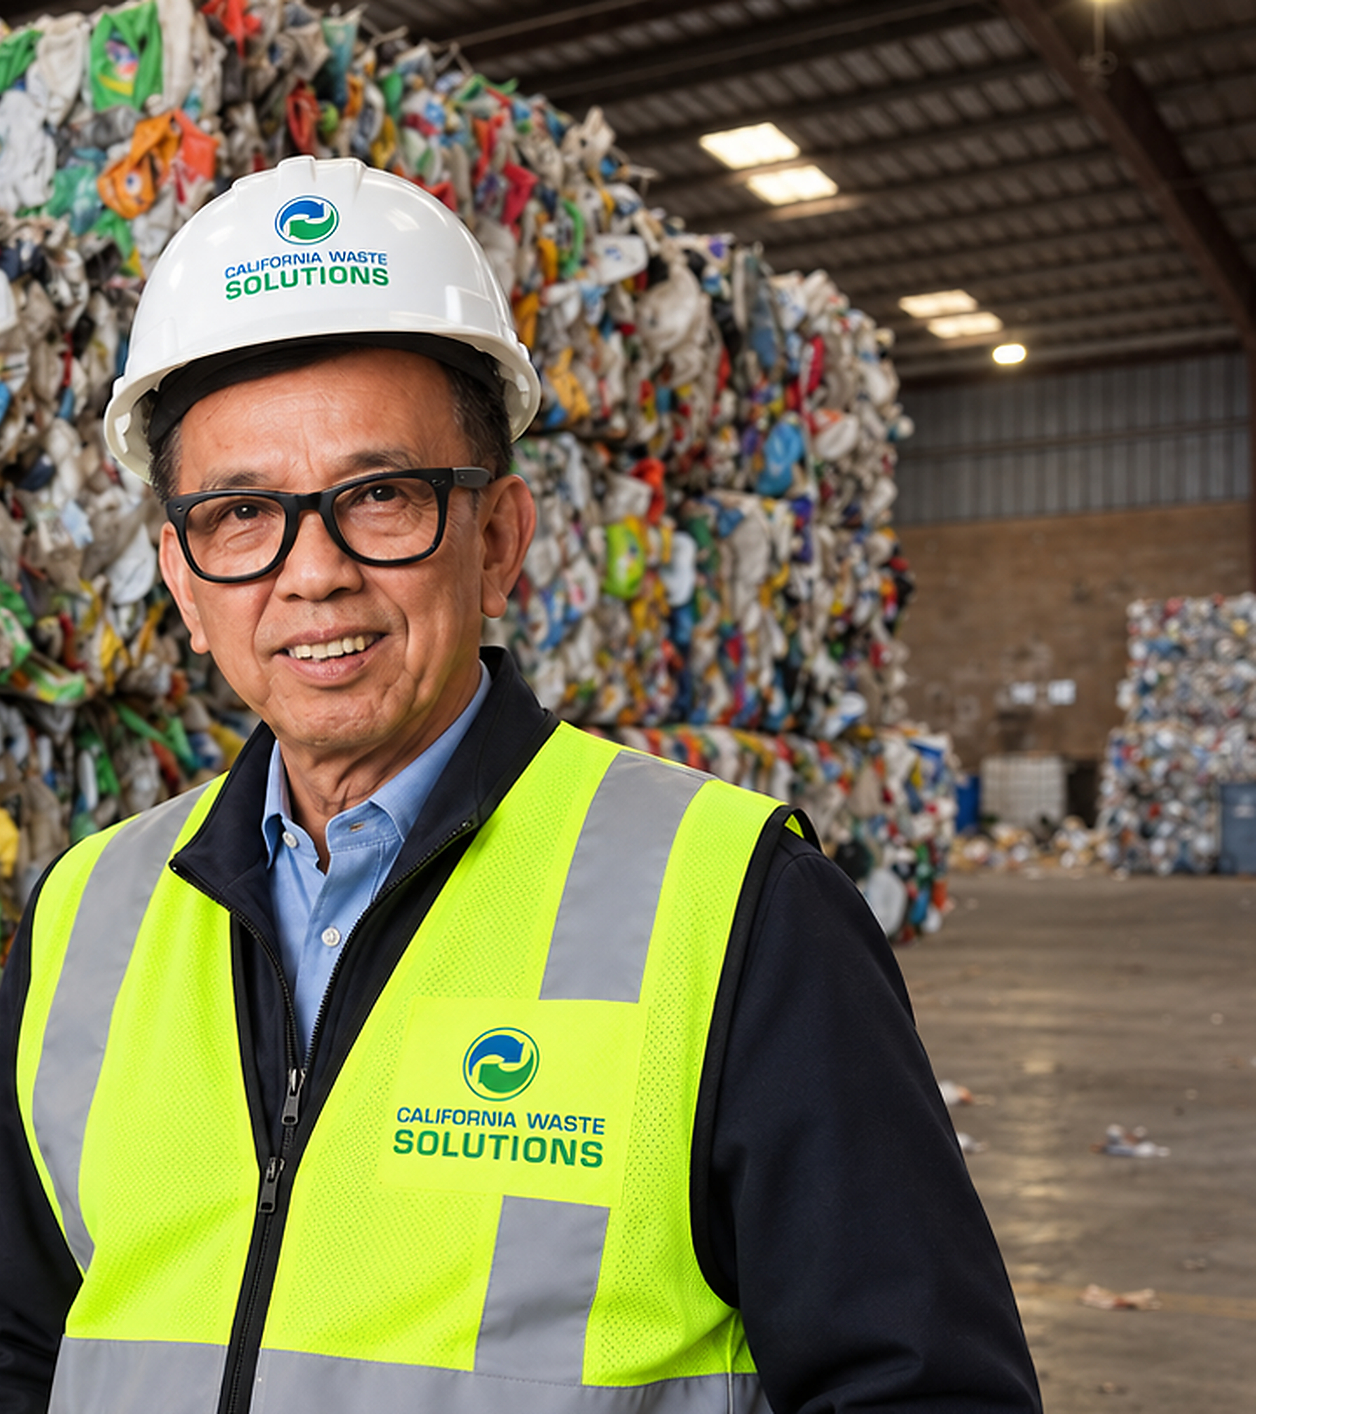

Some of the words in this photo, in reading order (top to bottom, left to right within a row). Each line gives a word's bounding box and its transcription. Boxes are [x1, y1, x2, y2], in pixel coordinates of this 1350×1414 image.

[225, 252, 322, 279] CALIFORNIA
[329, 251, 388, 266] WASTE
[226, 266, 389, 300] SOLUTIONS
[396, 1107, 517, 1128] CALIFORNIA
[527, 1113, 605, 1135] WASTE
[393, 1129, 603, 1168] SOLUTIONS
